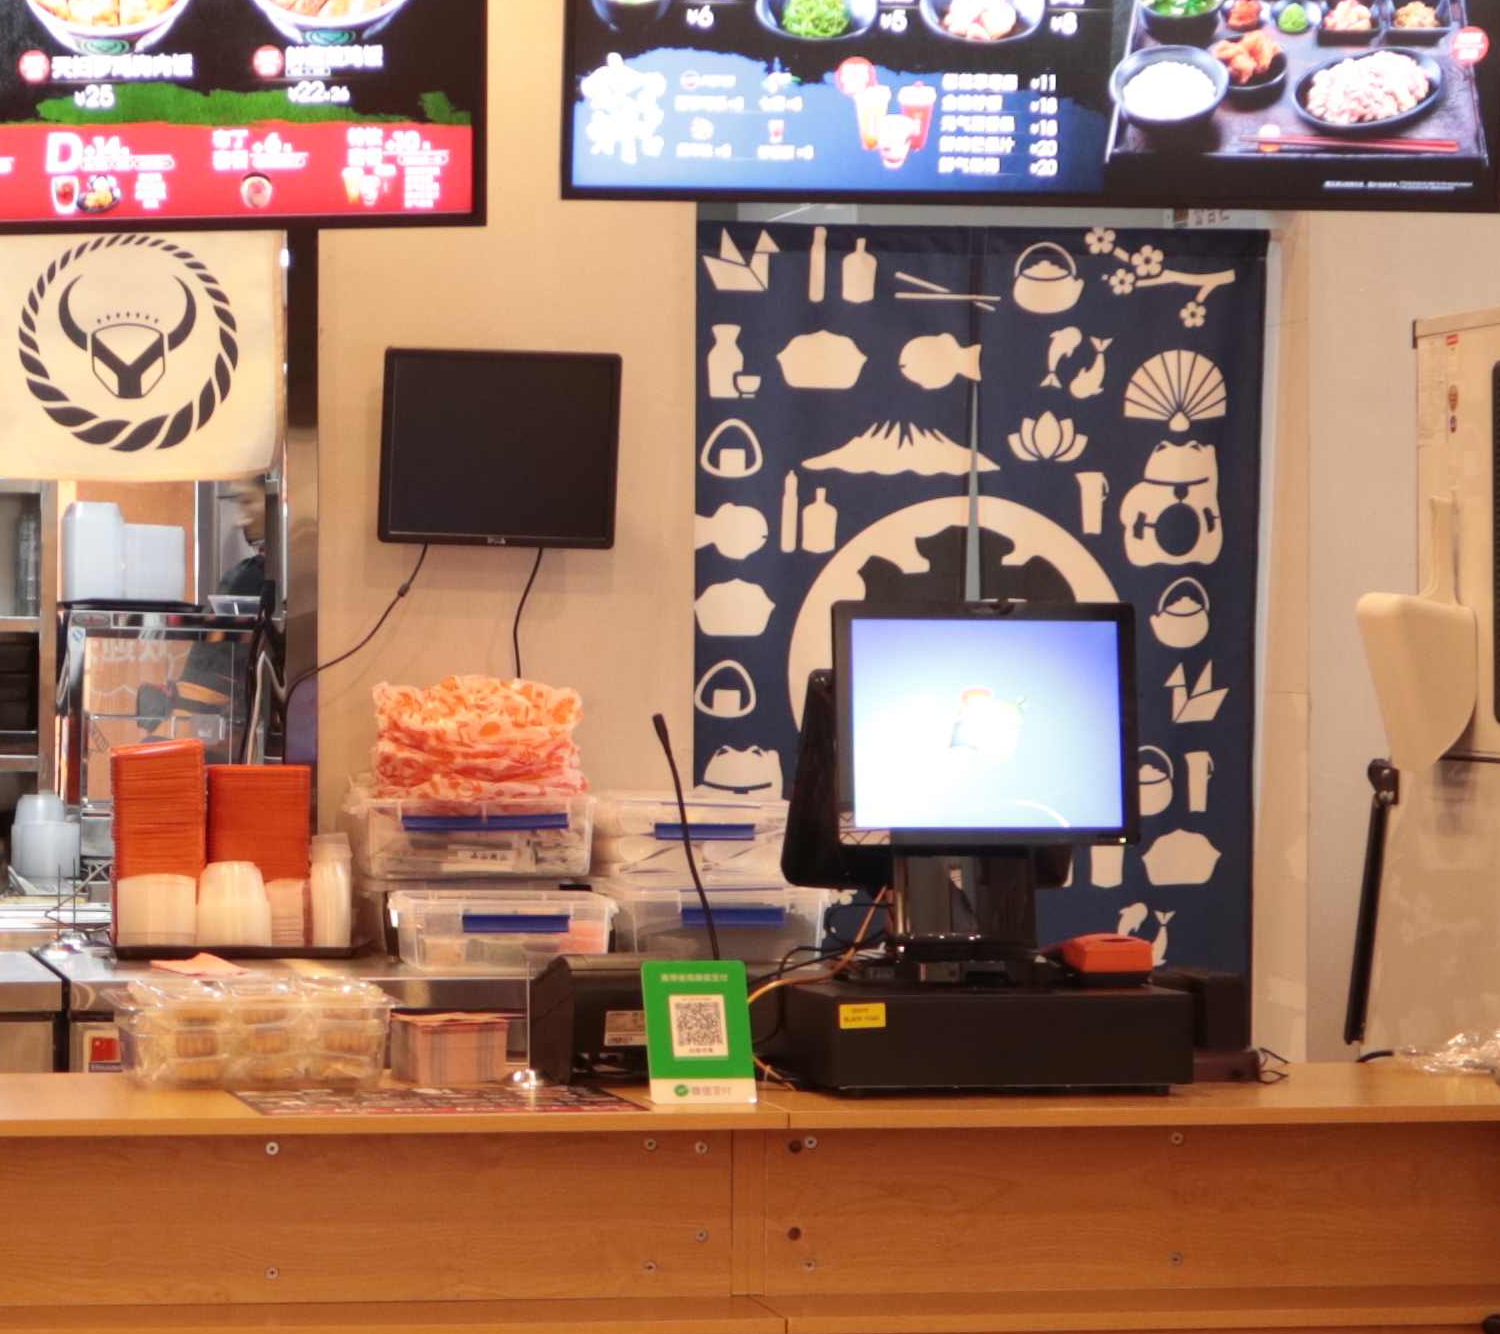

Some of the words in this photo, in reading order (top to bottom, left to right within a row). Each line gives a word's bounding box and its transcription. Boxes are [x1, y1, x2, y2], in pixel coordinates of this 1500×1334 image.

[687, 5, 713, 27] ¥6
[881, 9, 907, 31] ¥5
[288, 81, 326, 103] ¥22
[1031, 75, 1055, 90] ¥11
[75, 85, 114, 108] ¥25
[46, 133, 83, 173] D
